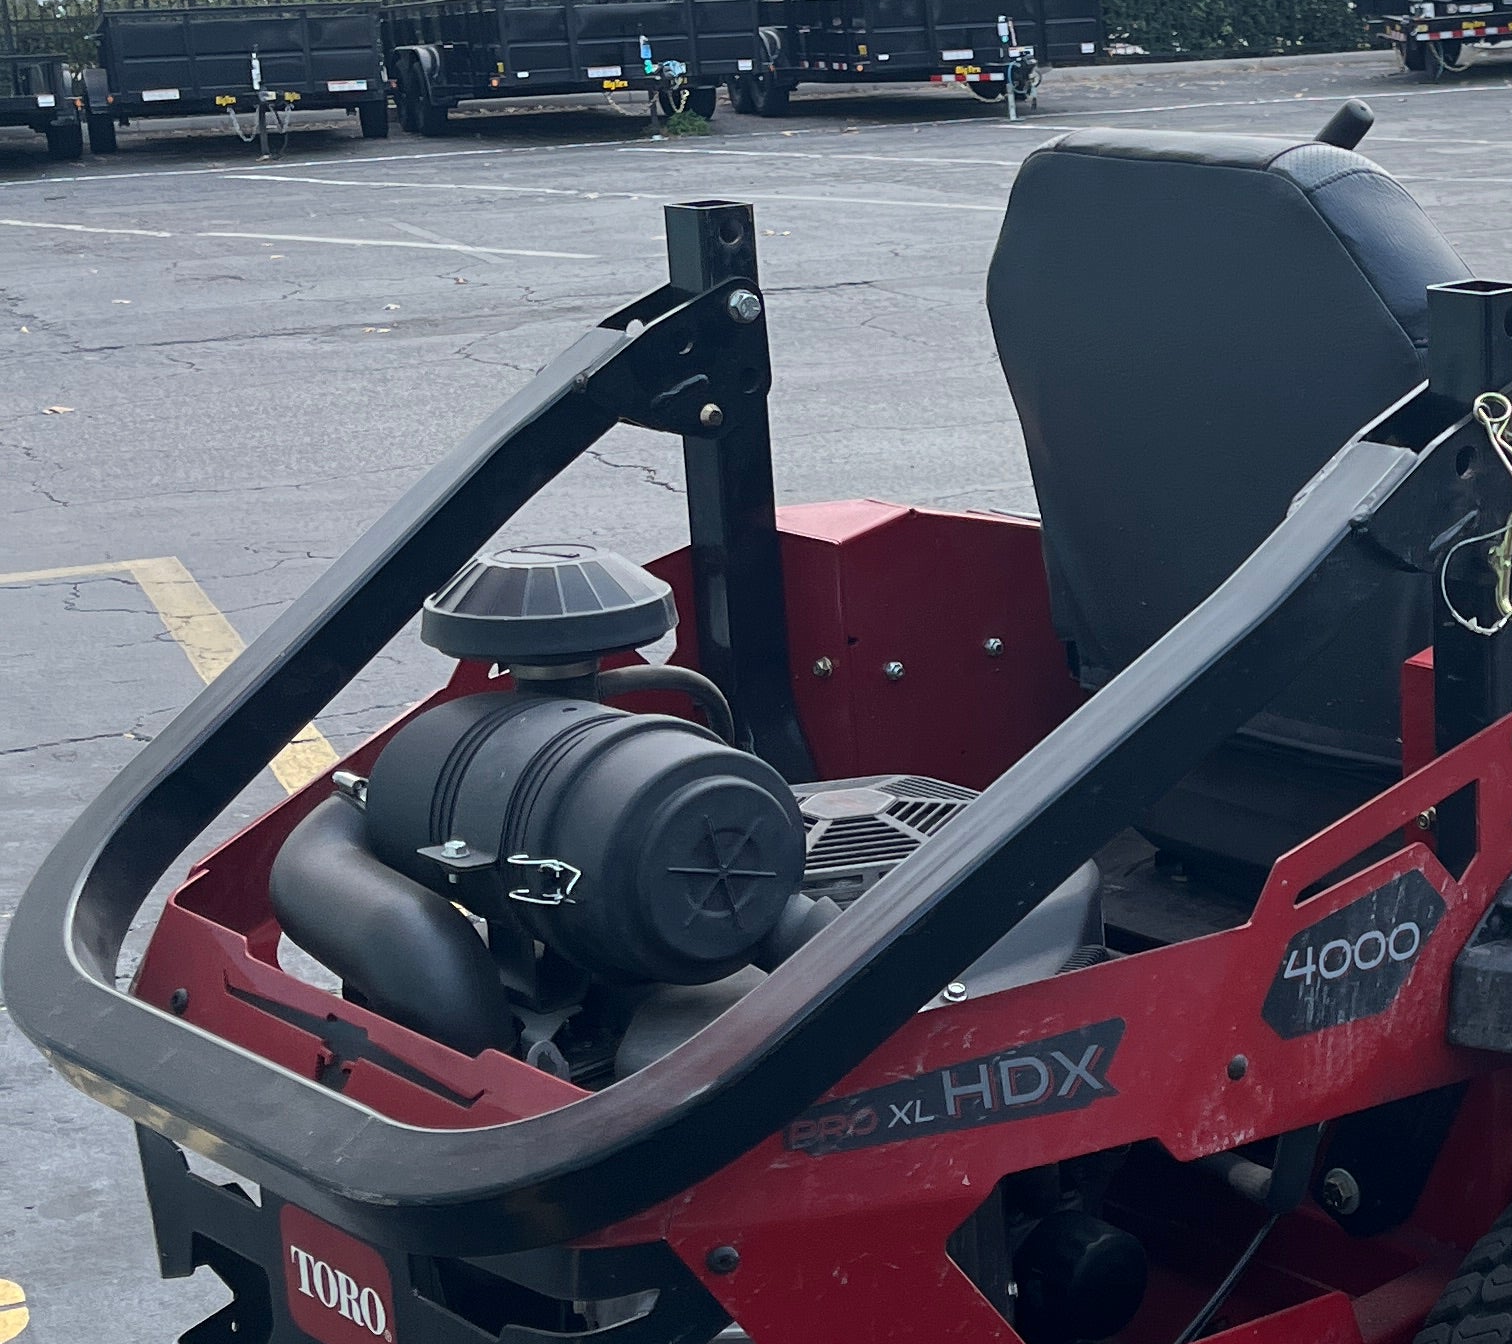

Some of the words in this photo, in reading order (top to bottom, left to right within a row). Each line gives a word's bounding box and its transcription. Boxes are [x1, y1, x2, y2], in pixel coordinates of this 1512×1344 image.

[1283, 921, 1421, 986] 4000
[790, 1107, 879, 1142] PRO
[887, 1099, 936, 1129] XL
[941, 1044, 1105, 1118] HDX
[290, 1244, 388, 1337] TORO
